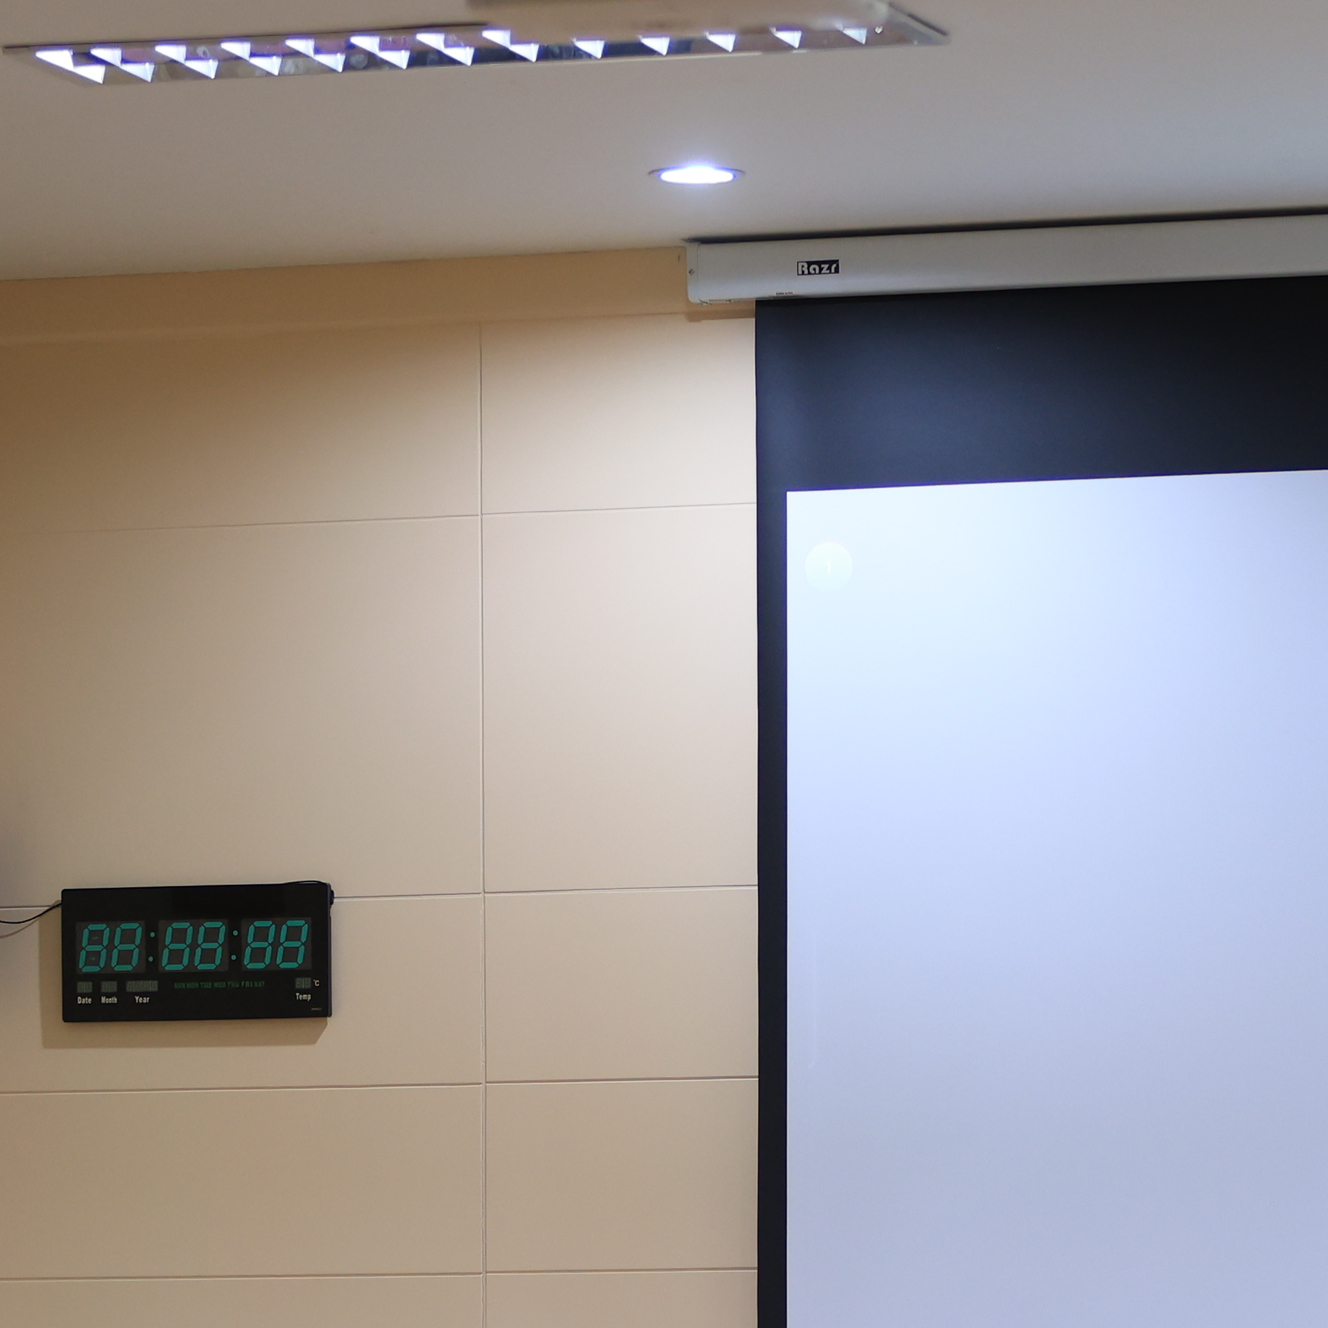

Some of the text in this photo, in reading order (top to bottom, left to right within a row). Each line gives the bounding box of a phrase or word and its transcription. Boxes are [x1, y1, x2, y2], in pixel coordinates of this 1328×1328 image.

[797, 261, 839, 275] Razr
[77, 996, 92, 1004] Date
[101, 996, 118, 1004] Month
[134, 996, 150, 1004] Year
[295, 992, 311, 1002] Temp
